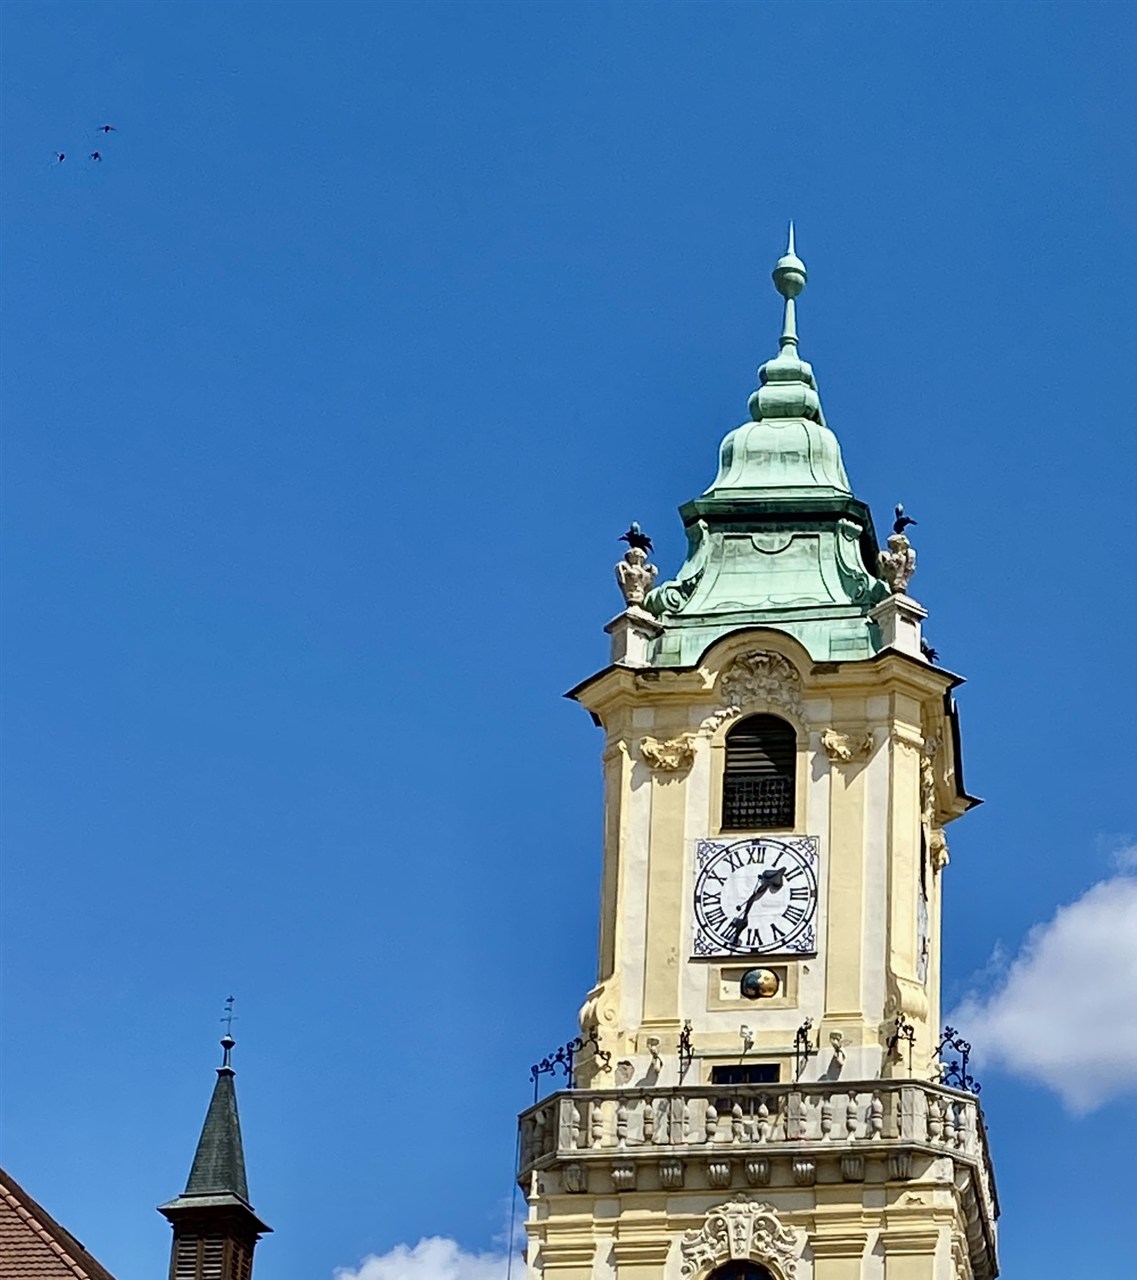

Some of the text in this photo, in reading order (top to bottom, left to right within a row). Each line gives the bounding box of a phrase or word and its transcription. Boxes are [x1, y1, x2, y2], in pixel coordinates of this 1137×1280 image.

[723, 852, 744, 872] XI
[746, 847, 766, 865] XII
[772, 852, 784, 867] I
[708, 870, 727, 886] X
[784, 865, 804, 882] II
[790, 886, 808, 901] III
[782, 905, 805, 926] IIII
[746, 928, 763, 946] VI
[770, 924, 785, 940] V
